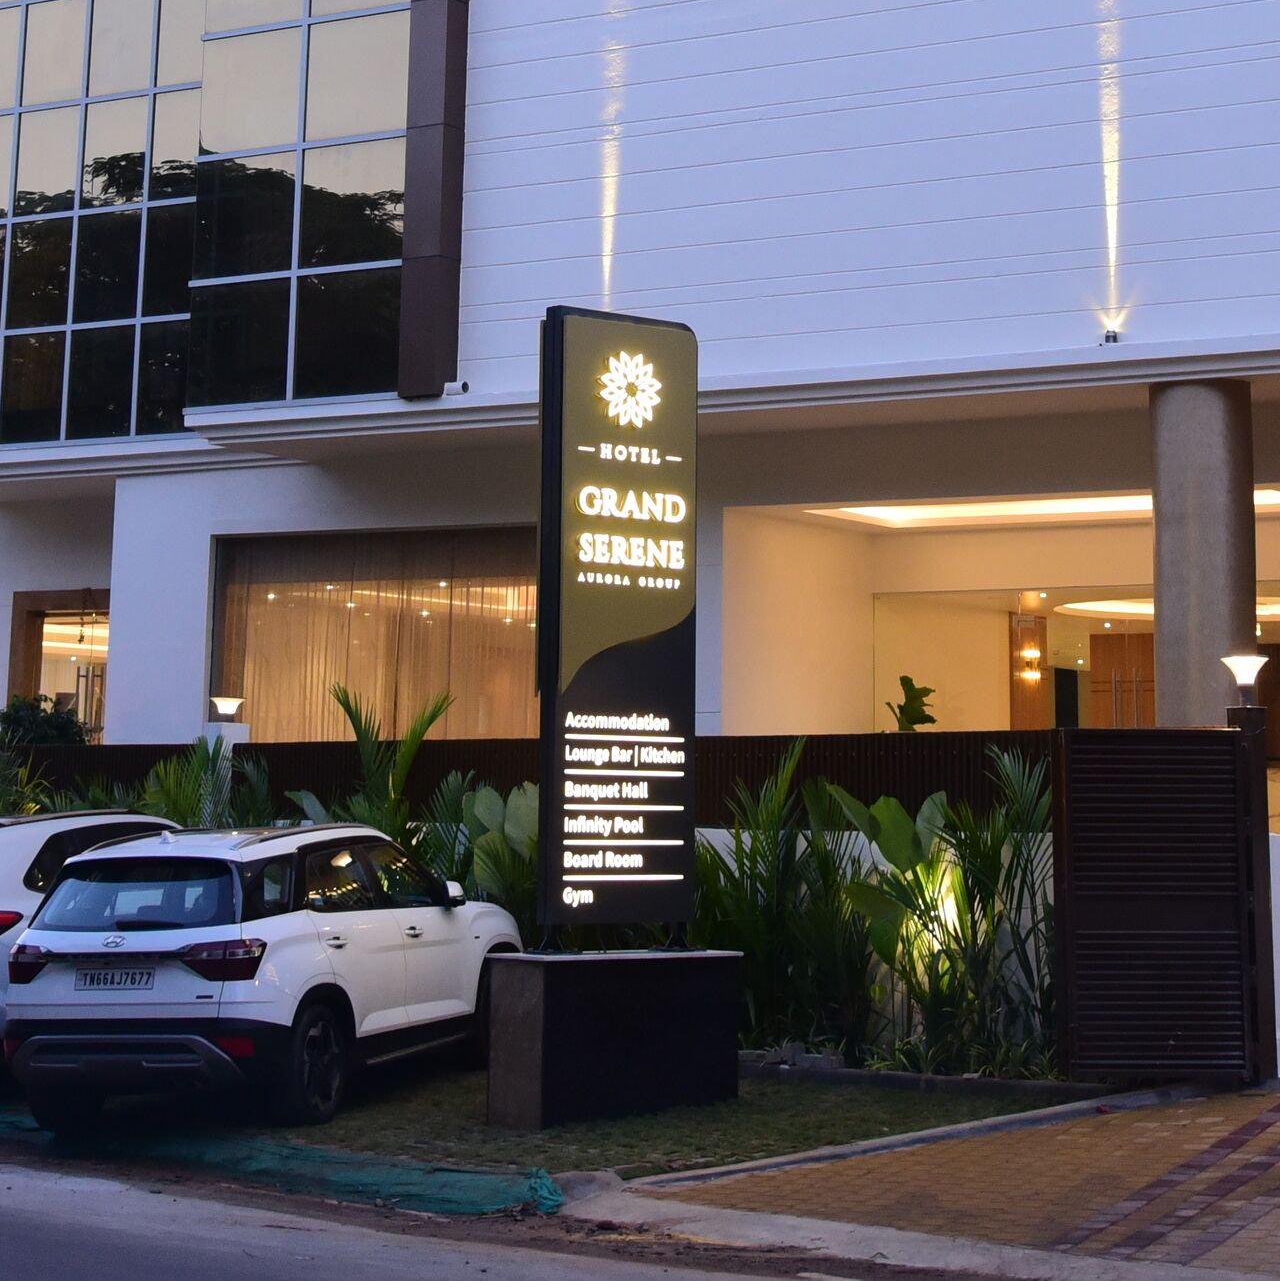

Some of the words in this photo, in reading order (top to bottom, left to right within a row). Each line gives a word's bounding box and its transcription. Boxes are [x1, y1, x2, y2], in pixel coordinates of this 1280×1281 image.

[599, 442, 661, 465] HOTEL
[578, 485, 686, 523] GRAND
[578, 532, 685, 569] SERENE
[577, 571, 631, 586] AURORA
[638, 576, 681, 590] GROUP
[565, 711, 670, 731] Accommodation
[565, 744, 610, 766] Lounge
[612, 746, 633, 763] Bar
[640, 746, 685, 764] Kitchen
[564, 781, 620, 801] Banquet
[622, 782, 649, 798] Hall
[564, 815, 613, 837] Infinity
[614, 816, 644, 834] Pool
[563, 850, 603, 868] Board
[605, 851, 644, 868] Room
[562, 886, 594, 908] Gym
[83, 971, 152, 986] TN66AJ7677
